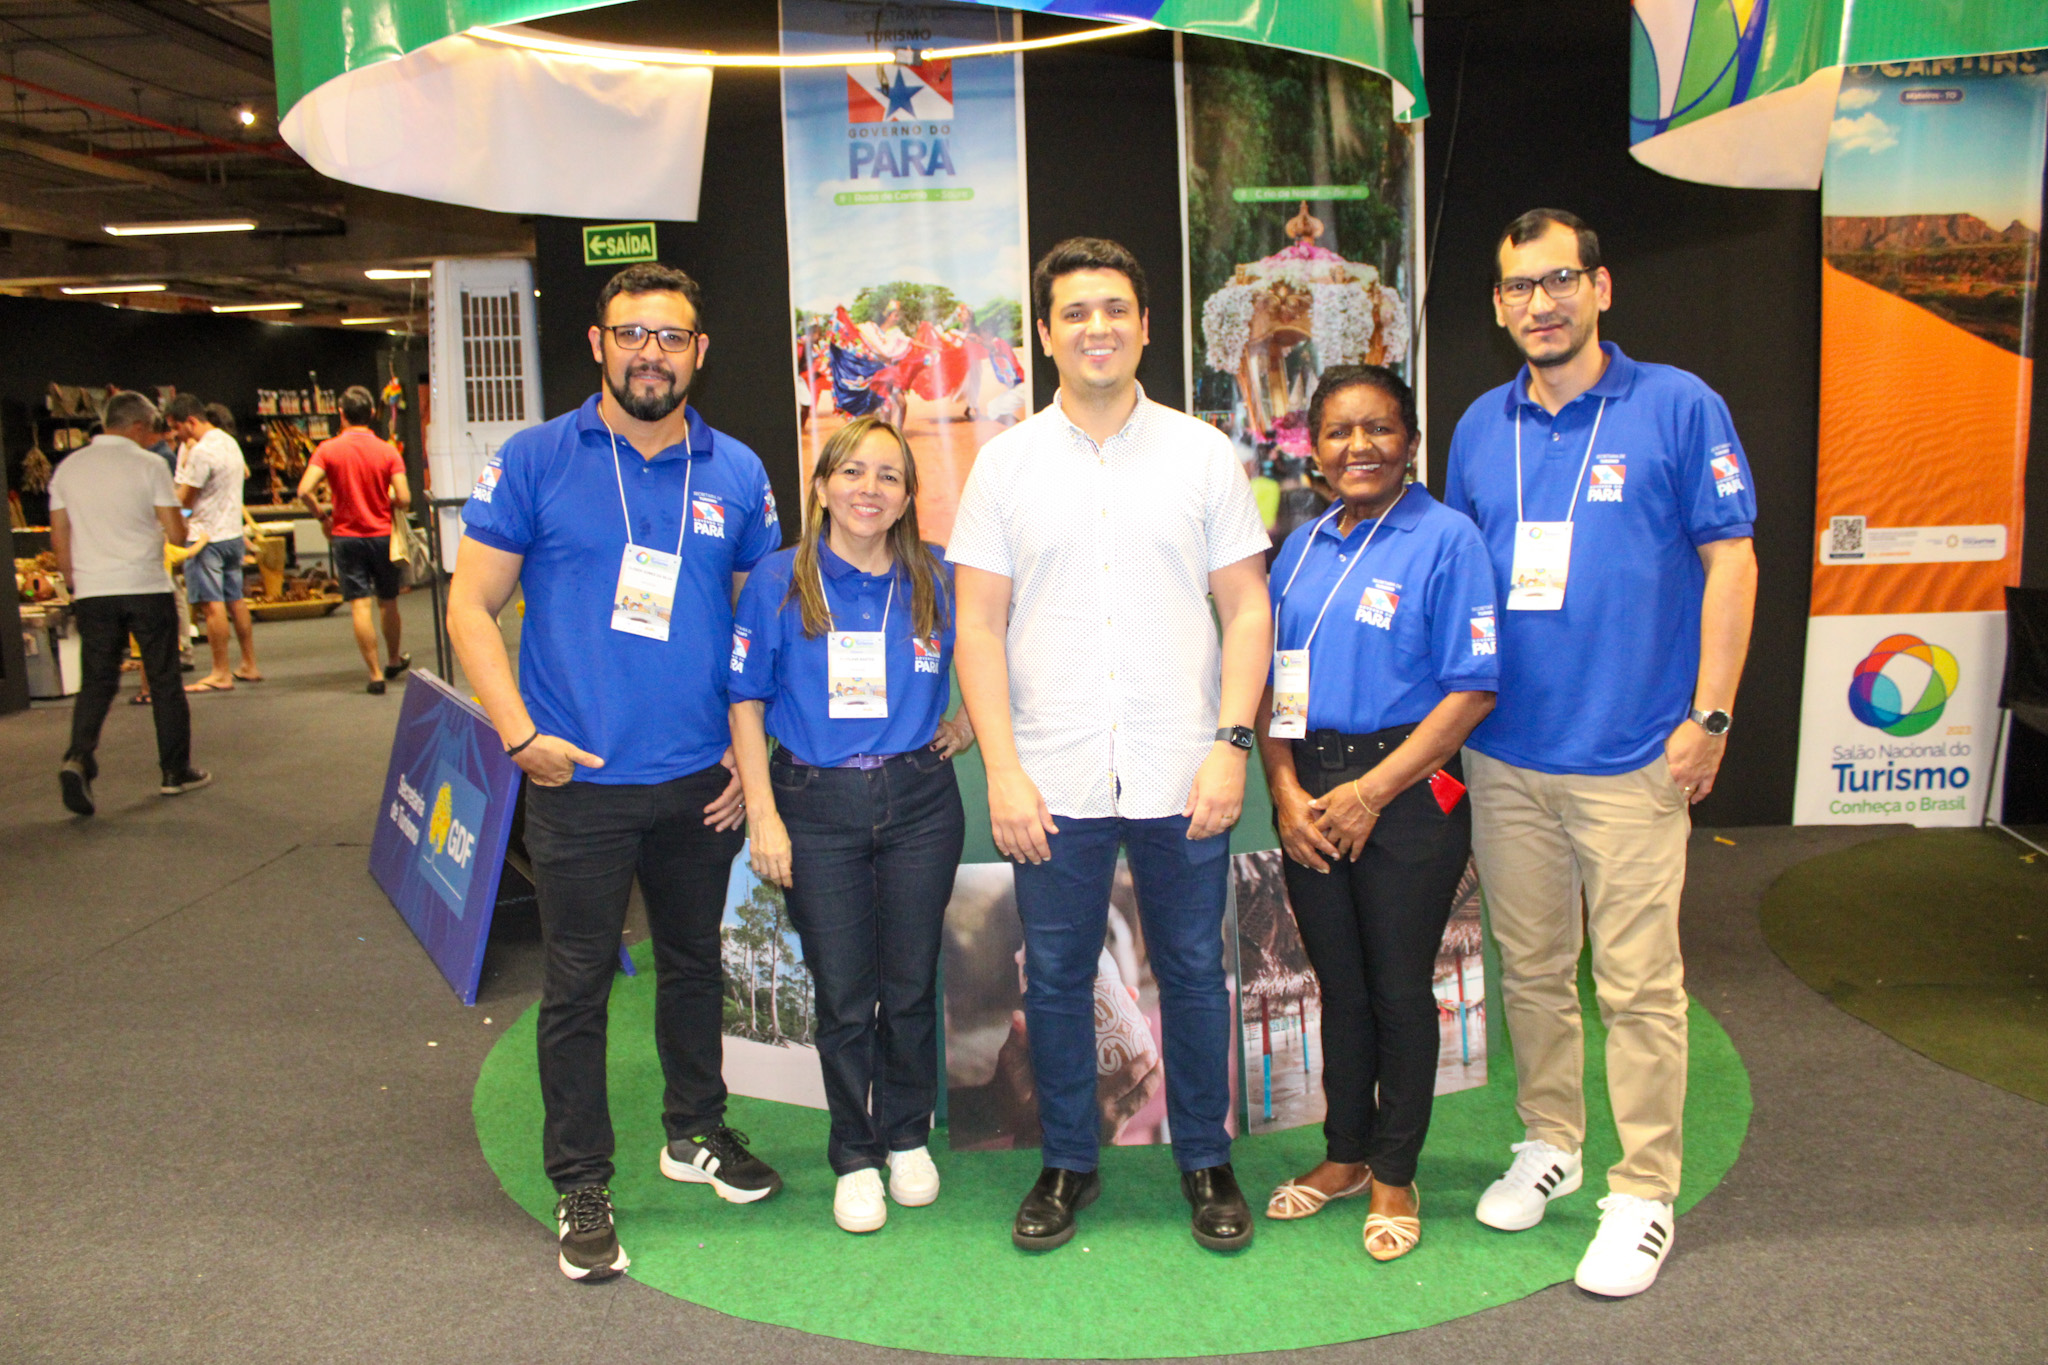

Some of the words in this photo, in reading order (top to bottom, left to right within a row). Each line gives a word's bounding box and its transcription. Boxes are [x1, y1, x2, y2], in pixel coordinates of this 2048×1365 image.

[864, 28, 932, 43] TURISMO
[848, 125, 922, 138] GOVERNO
[930, 124, 951, 136] DO
[606, 231, 651, 256] SAÍDA
[1833, 744, 1877, 761] Salão
[1879, 742, 1947, 759] Nacional
[1950, 741, 1971, 757] do
[1831, 761, 1971, 792] Turismo
[397, 773, 426, 818] Secretaria
[1829, 799, 1902, 816] Conheça
[1905, 802, 1917, 812] o
[1919, 796, 1966, 812] Brasil
[390, 799, 399, 822] de
[397, 804, 420, 847] Turismo
[447, 818, 475, 870] GDF
